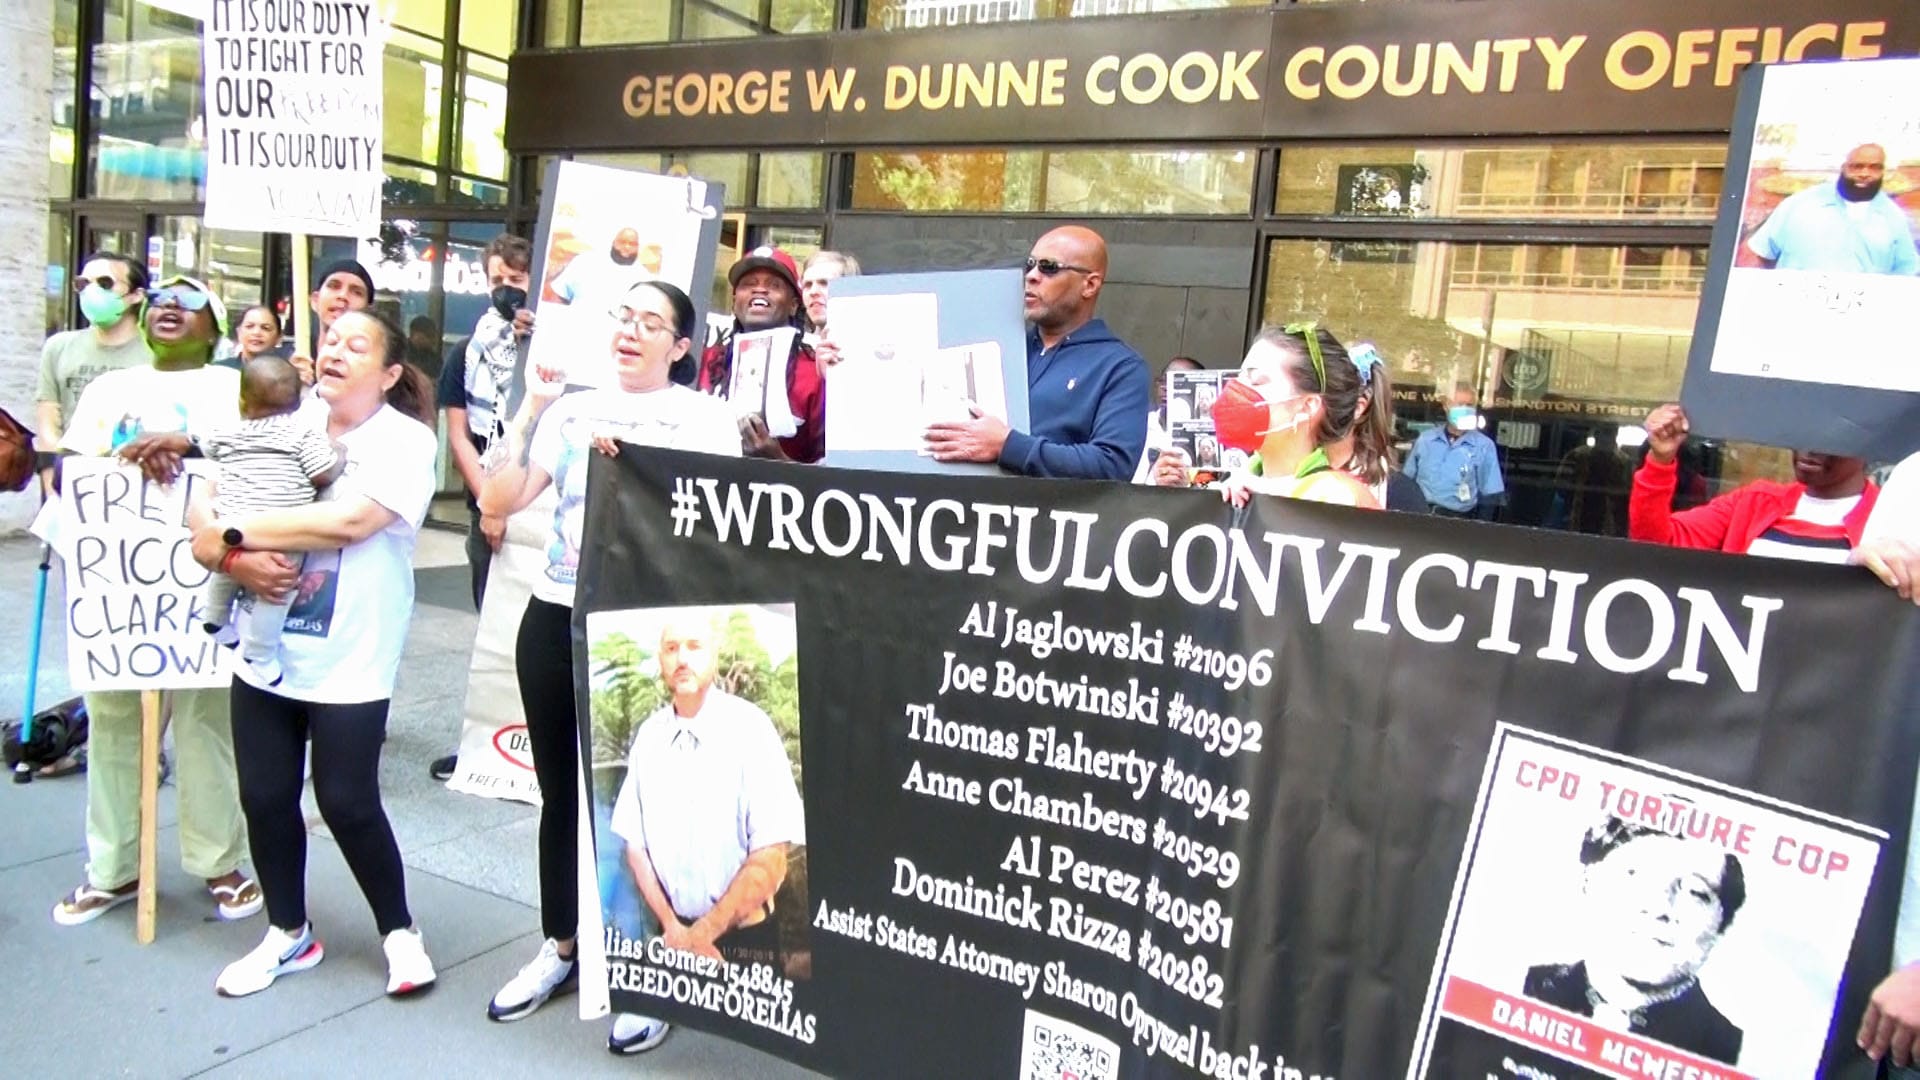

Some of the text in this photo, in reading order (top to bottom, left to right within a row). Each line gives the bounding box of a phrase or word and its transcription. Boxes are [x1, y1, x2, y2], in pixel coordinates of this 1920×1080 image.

[213, 0, 370, 37] IT IS OUR DUTY
[215, 37, 364, 76] TO FIGHT FOR
[216, 76, 276, 119] OUR
[622, 21, 1887, 118] GEORGE W. DUNNE COOK COUNTY OFFICE
[221, 128, 377, 172] IT IS OUR DUTY
[77, 536, 212, 589] RICO
[670, 476, 1784, 693] #WRONGFULCONVICTION
[70, 593, 206, 639] CLARK
[958, 600, 1275, 689] Al Jaglowski #21096
[87, 641, 219, 681] NOW!
[938, 651, 1264, 756] Joe Botwinski #20392
[905, 703, 1251, 825] Thomas Flaherty #20942
[901, 760, 1241, 887] Anne Chambers #20529
[1515, 759, 1850, 881] CPD TORTURE COP
[891, 857, 1225, 1010] Dominick Rizza #20282
[999, 835, 1234, 949] Al Perez #20581
[604, 926, 795, 1006] lias Gomez 1548845
[812, 898, 873, 943] Assist
[875, 914, 938, 961] States
[938, 934, 1041, 1000] Attorney
[1043, 960, 1118, 1020] Sharon
[1120, 991, 1198, 1068] Opryszel
[1199, 1030, 1268, 1080] back
[1490, 998, 1588, 1054] DANIEL
